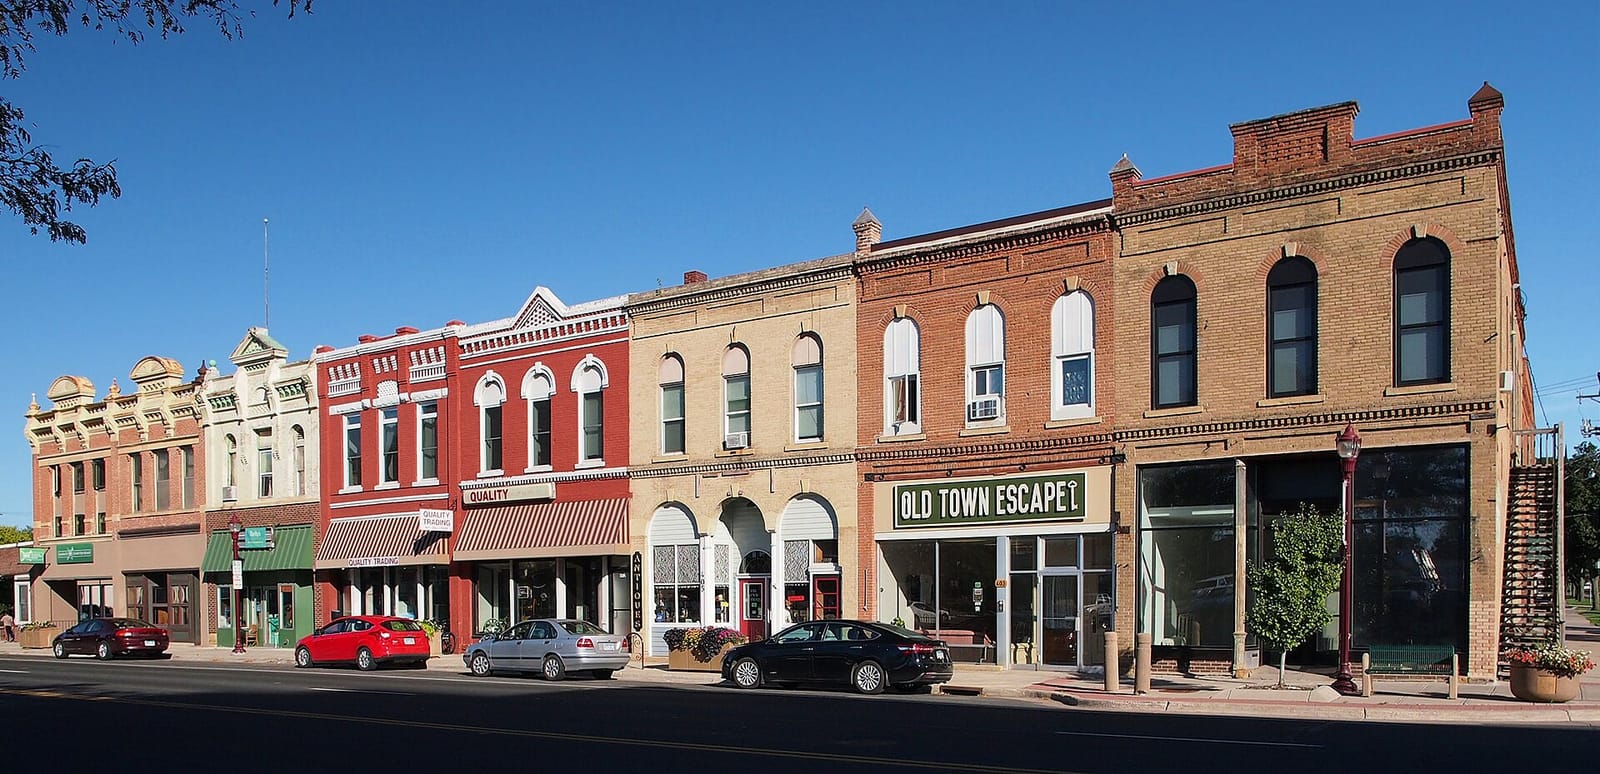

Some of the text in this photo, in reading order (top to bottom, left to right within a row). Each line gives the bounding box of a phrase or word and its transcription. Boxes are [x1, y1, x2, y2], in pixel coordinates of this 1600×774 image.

[470, 489, 509, 502] QUALITY
[901, 481, 1067, 520] OLD TOWN ESCAPE
[422, 510, 450, 519] QUALITY
[423, 518, 451, 527] TRADING
[349, 556, 399, 567] QUALITY TRADING
